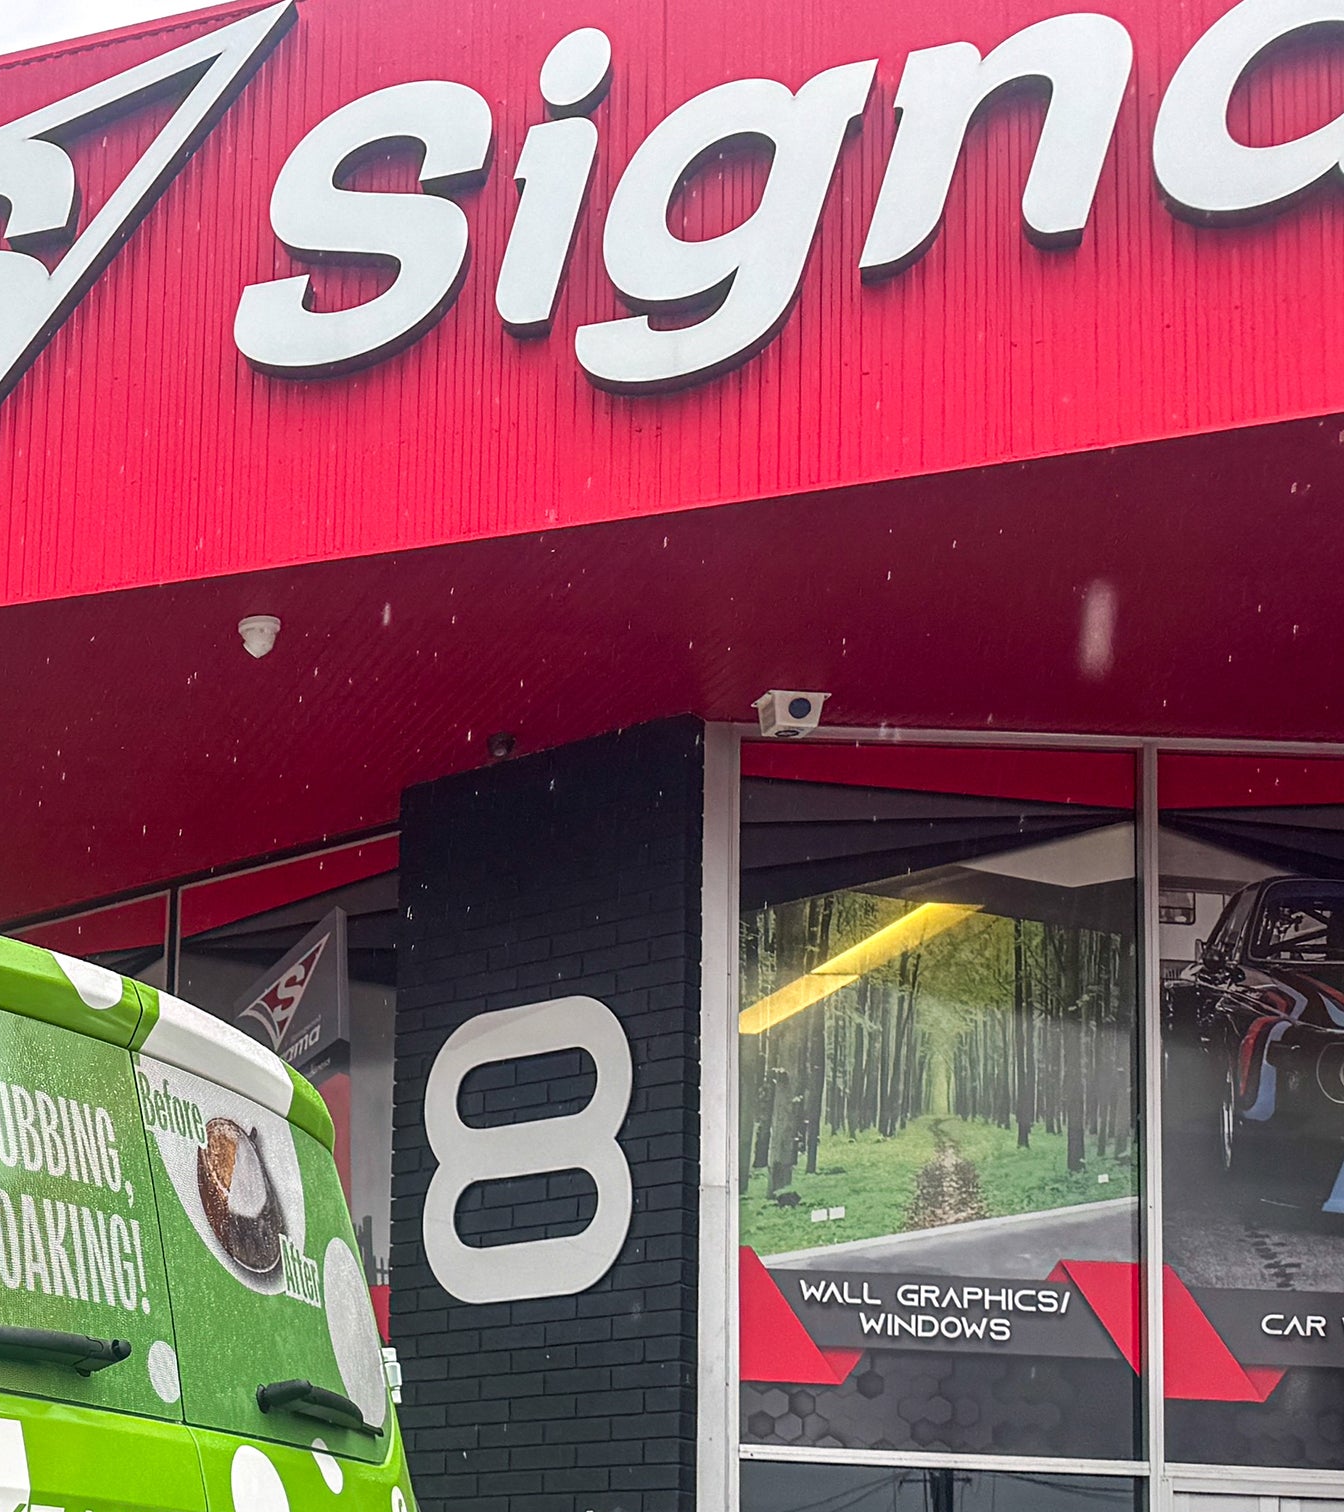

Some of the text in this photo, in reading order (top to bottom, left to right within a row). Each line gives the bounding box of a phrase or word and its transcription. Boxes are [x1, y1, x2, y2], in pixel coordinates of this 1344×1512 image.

[138, 1071, 206, 1144] Before
[422, 995, 633, 1304] 8
[798, 1279, 1071, 1315] WALL GRAPHICS/
[858, 1312, 1011, 1341] WINDOWS
[1261, 1314, 1327, 1337] CAR
